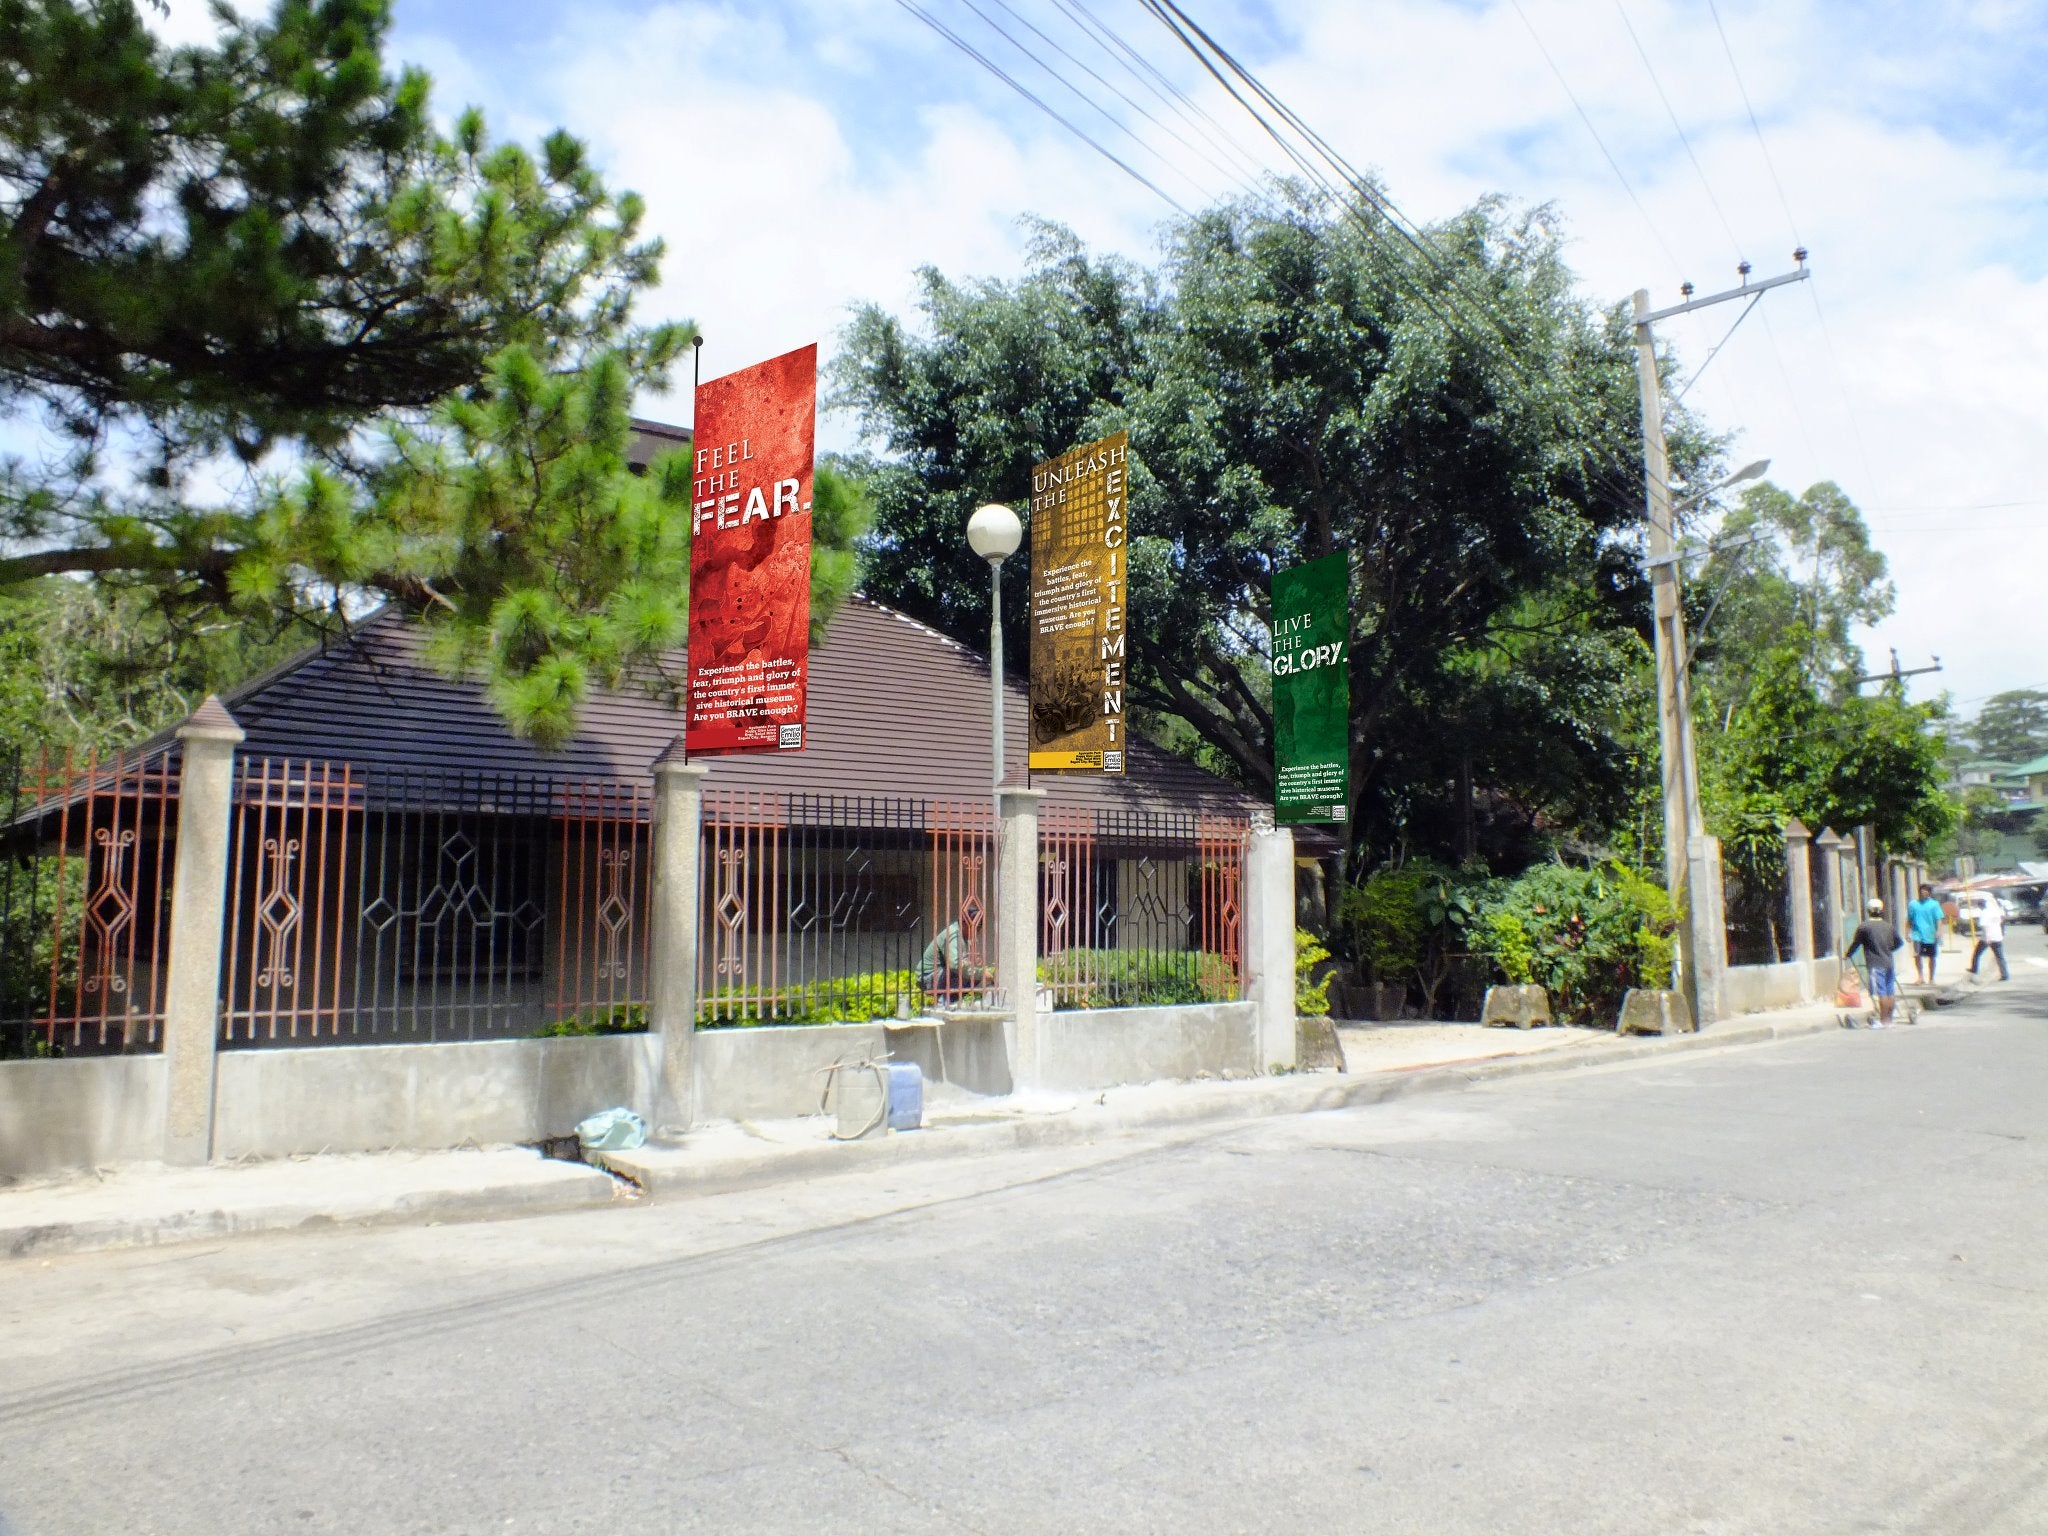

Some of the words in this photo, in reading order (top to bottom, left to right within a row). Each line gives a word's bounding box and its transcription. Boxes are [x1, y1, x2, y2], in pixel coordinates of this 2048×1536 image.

[696, 439, 753, 474] FEEL
[1034, 445, 1125, 492] UNLEASH
[694, 470, 739, 497] THE
[693, 478, 811, 536] FEAR.
[1033, 489, 1066, 511] THE
[1043, 563, 1079, 577] Experience
[1081, 560, 1092, 568] the
[1046, 575, 1071, 585] battles,
[1072, 571, 1087, 579] fear,
[1035, 587, 1060, 597] triumph
[1061, 583, 1074, 591] and
[1075, 579, 1093, 589] glory
[1095, 576, 1101, 584] of
[1051, 592, 1080, 604] country's
[1082, 588, 1096, 596] first
[1035, 605, 1067, 616] immersive
[1069, 596, 1101, 608] historical
[1101, 469, 1125, 743] EXCITEMENT
[1039, 615, 1067, 624] museum.
[1069, 611, 1081, 619] Are
[1083, 609, 1095, 617] you
[1040, 624, 1064, 634] BRAVE
[1065, 618, 1094, 629] enough?
[1274, 613, 1311, 637] LIVE
[1273, 635, 1301, 653] THE
[699, 666, 744, 676] Experience
[746, 662, 759, 670] the
[762, 658, 795, 668] battles,
[1274, 641, 1347, 676] GLORY.
[693, 680, 711, 688] fear,
[713, 675, 745, 686] triumph
[748, 672, 764, 681] and
[766, 671, 790, 681] glory
[792, 668, 801, 676] of
[708, 687, 745, 697] country's
[748, 685, 765, 693] first
[767, 682, 799, 690] immer-
[715, 697, 753, 708] historical
[756, 696, 795, 704] museum.
[694, 713, 708, 721] Are
[710, 712, 724, 721] you
[727, 709, 758, 718] BRAVE
[760, 705, 798, 715] enough?
